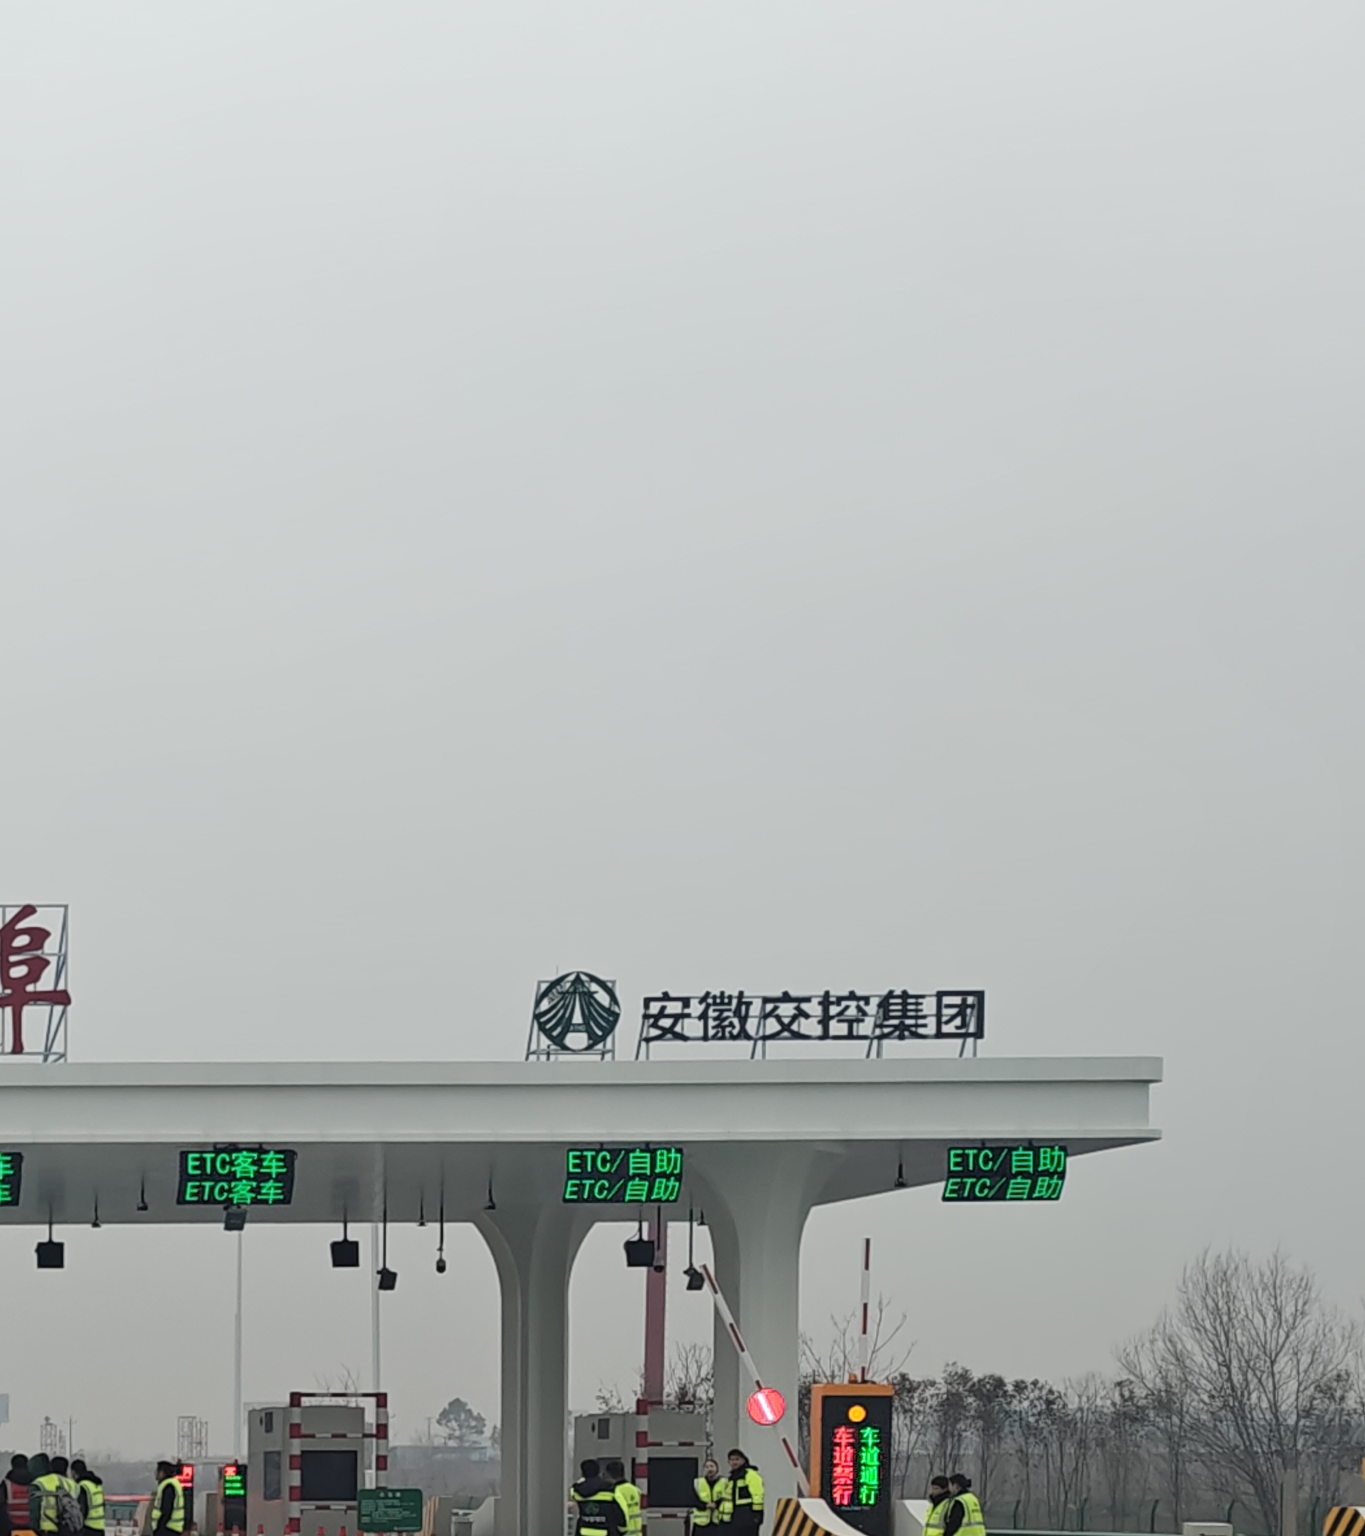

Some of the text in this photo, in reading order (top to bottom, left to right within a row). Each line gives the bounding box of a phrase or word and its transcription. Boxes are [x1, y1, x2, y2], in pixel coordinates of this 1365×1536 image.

[641, 990, 985, 1042] 安徽交控集团
[187, 1150, 287, 1178] ETC客车
[569, 1148, 682, 1174] ETC/自助
[949, 1146, 1065, 1172] ETC/自助
[184, 1179, 285, 1204] ETC客车
[564, 1177, 680, 1201] ETC/自助
[944, 1175, 1062, 1199] ETC/自助
[859, 1426, 881, 1505] 车道通行
